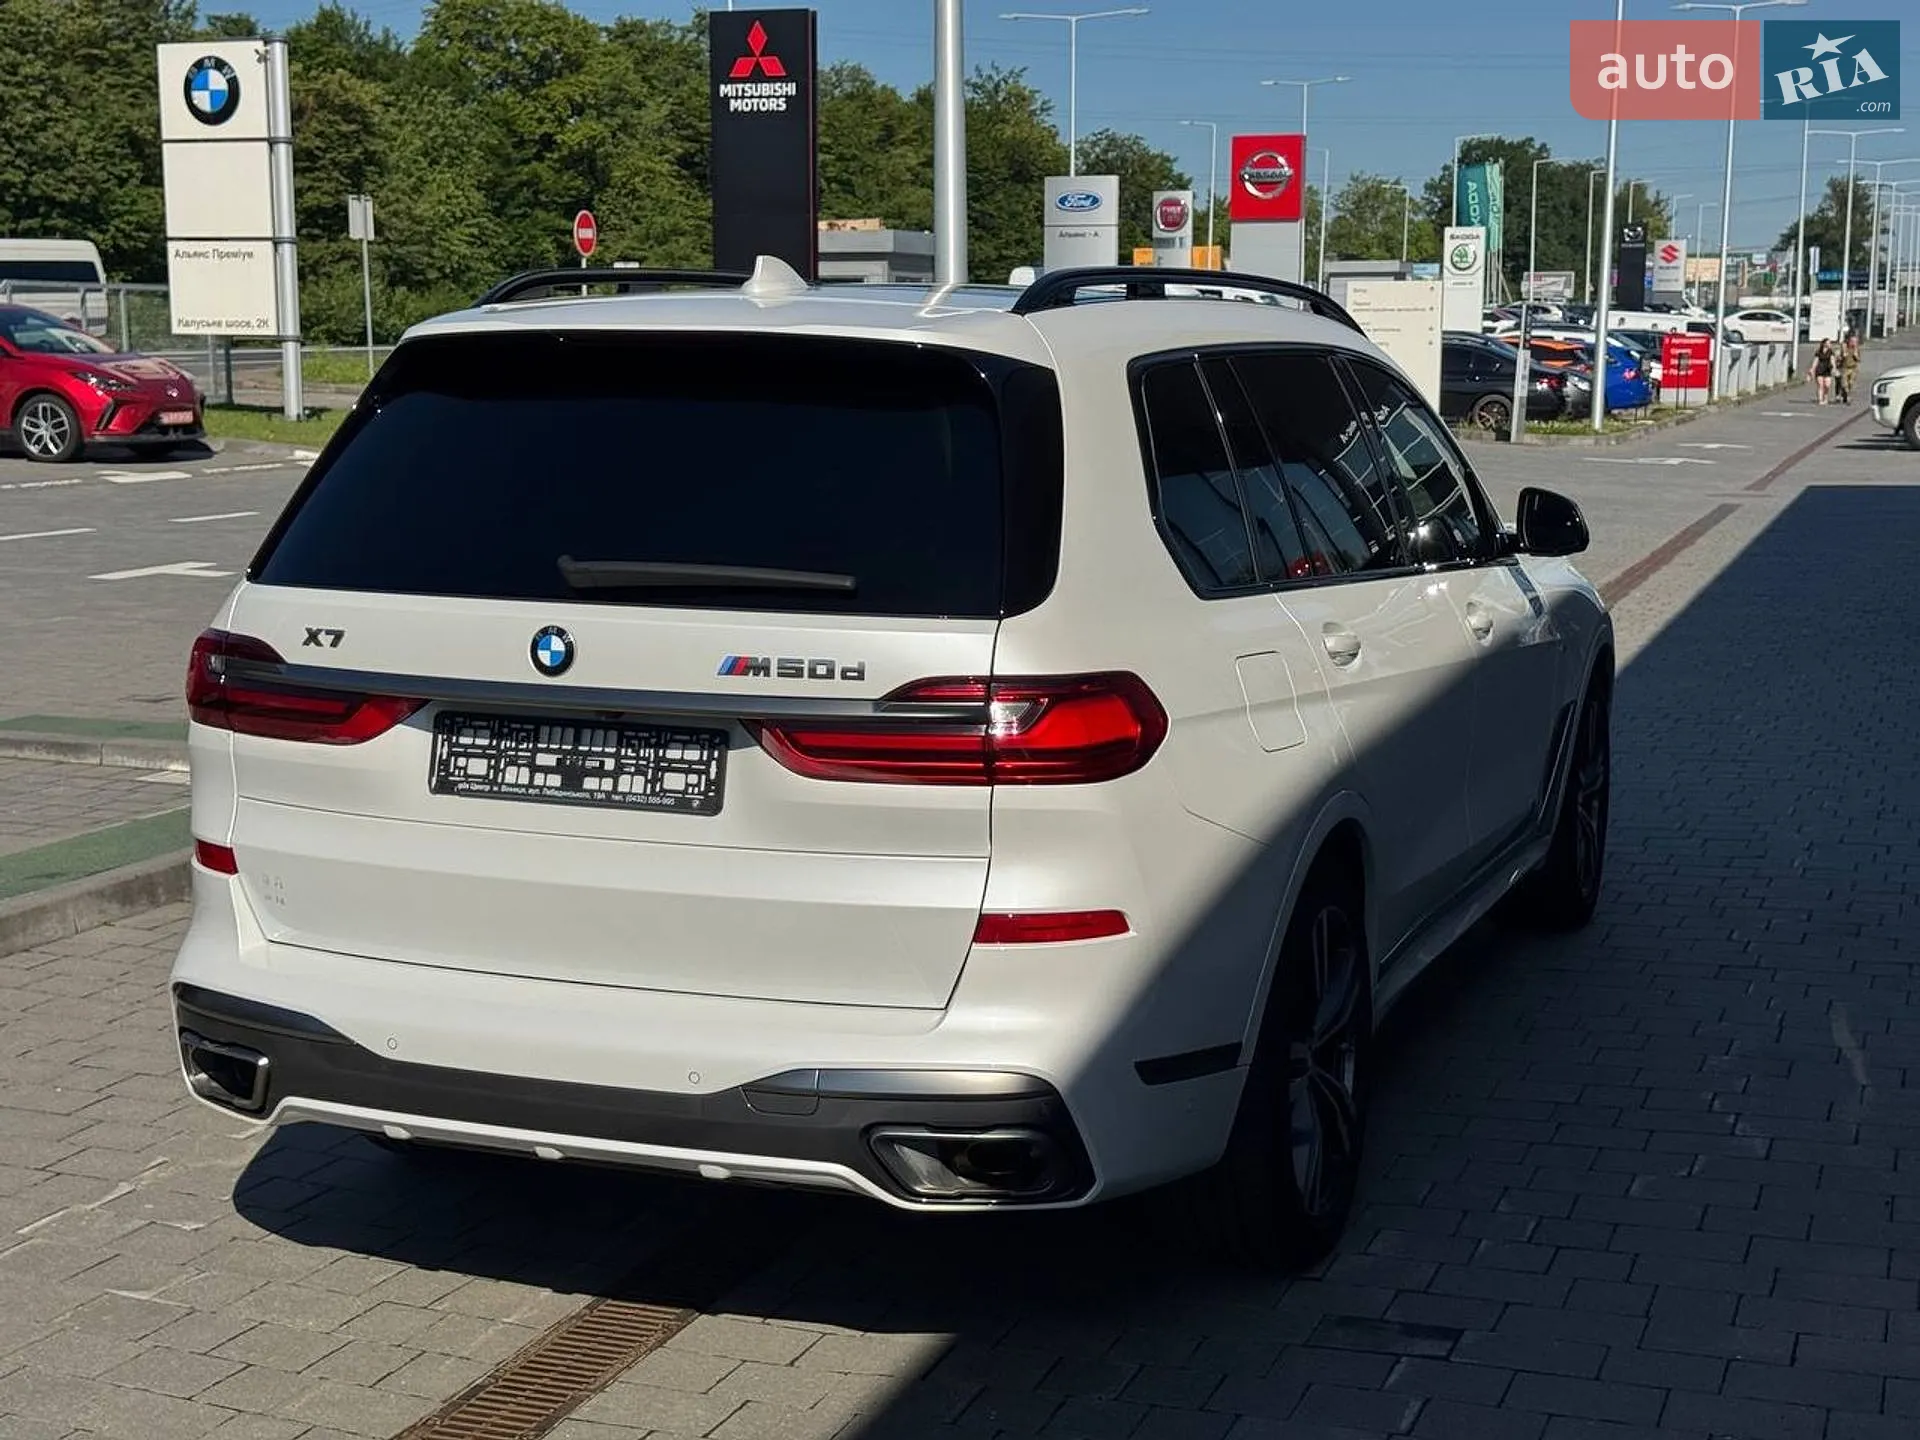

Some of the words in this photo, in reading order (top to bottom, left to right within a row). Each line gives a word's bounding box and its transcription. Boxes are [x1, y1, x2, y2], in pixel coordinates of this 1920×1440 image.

[719, 82, 797, 97] MITSUBISHI
[730, 98, 787, 112] MOTORS
[302, 627, 345, 648] X7
